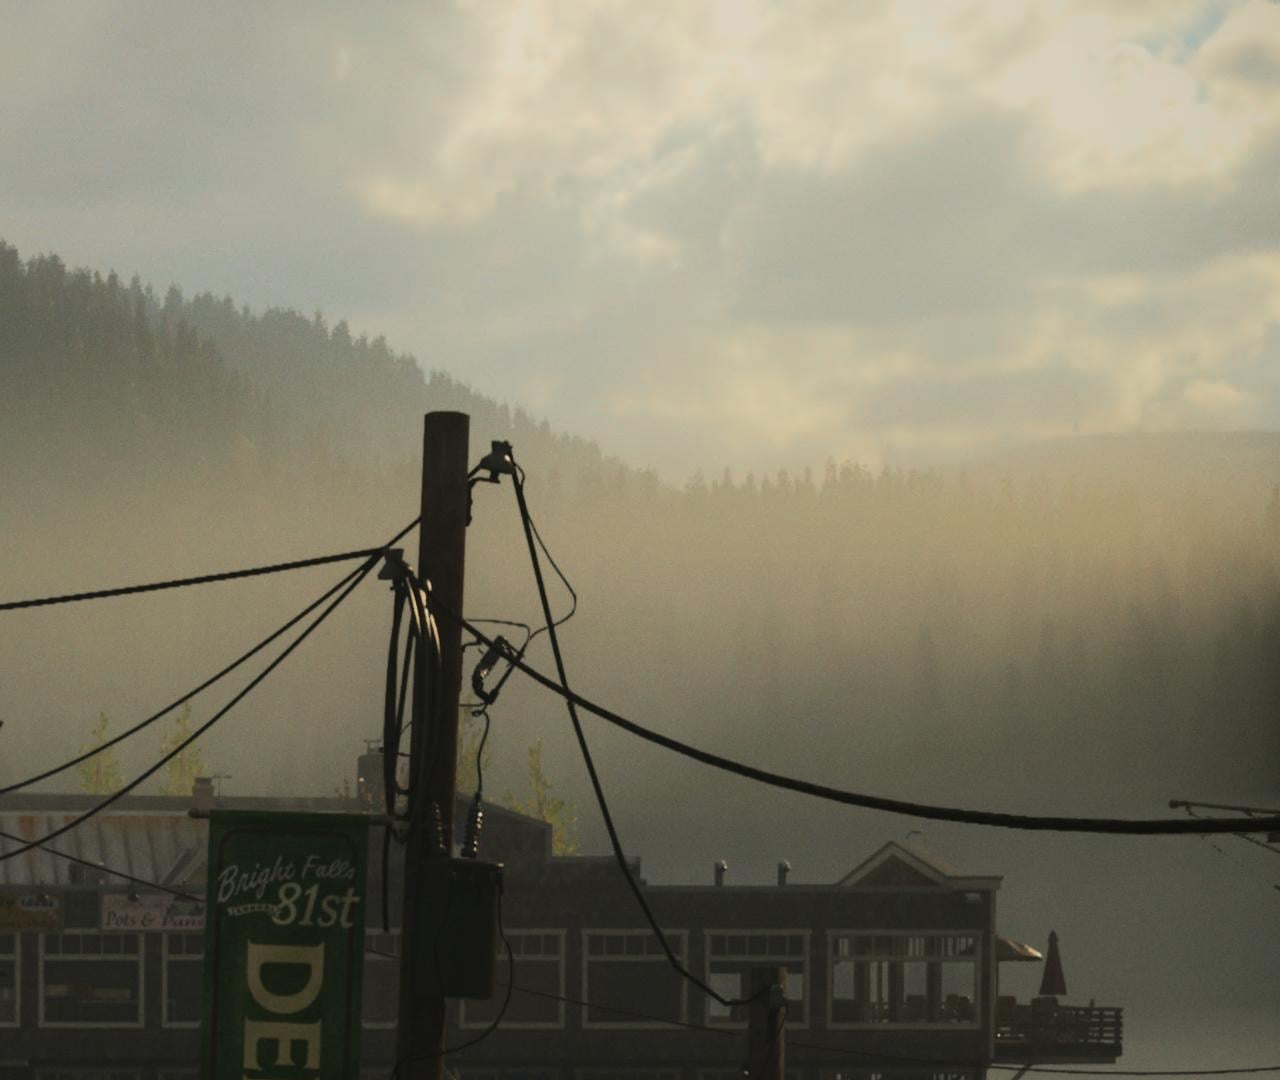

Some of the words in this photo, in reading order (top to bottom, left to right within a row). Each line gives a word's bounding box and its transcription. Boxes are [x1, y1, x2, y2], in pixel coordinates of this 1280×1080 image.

[216, 855, 297, 904] Bright
[301, 853, 356, 880] Falls
[106, 911, 136, 927] Pots
[271, 881, 360, 929] 81st
